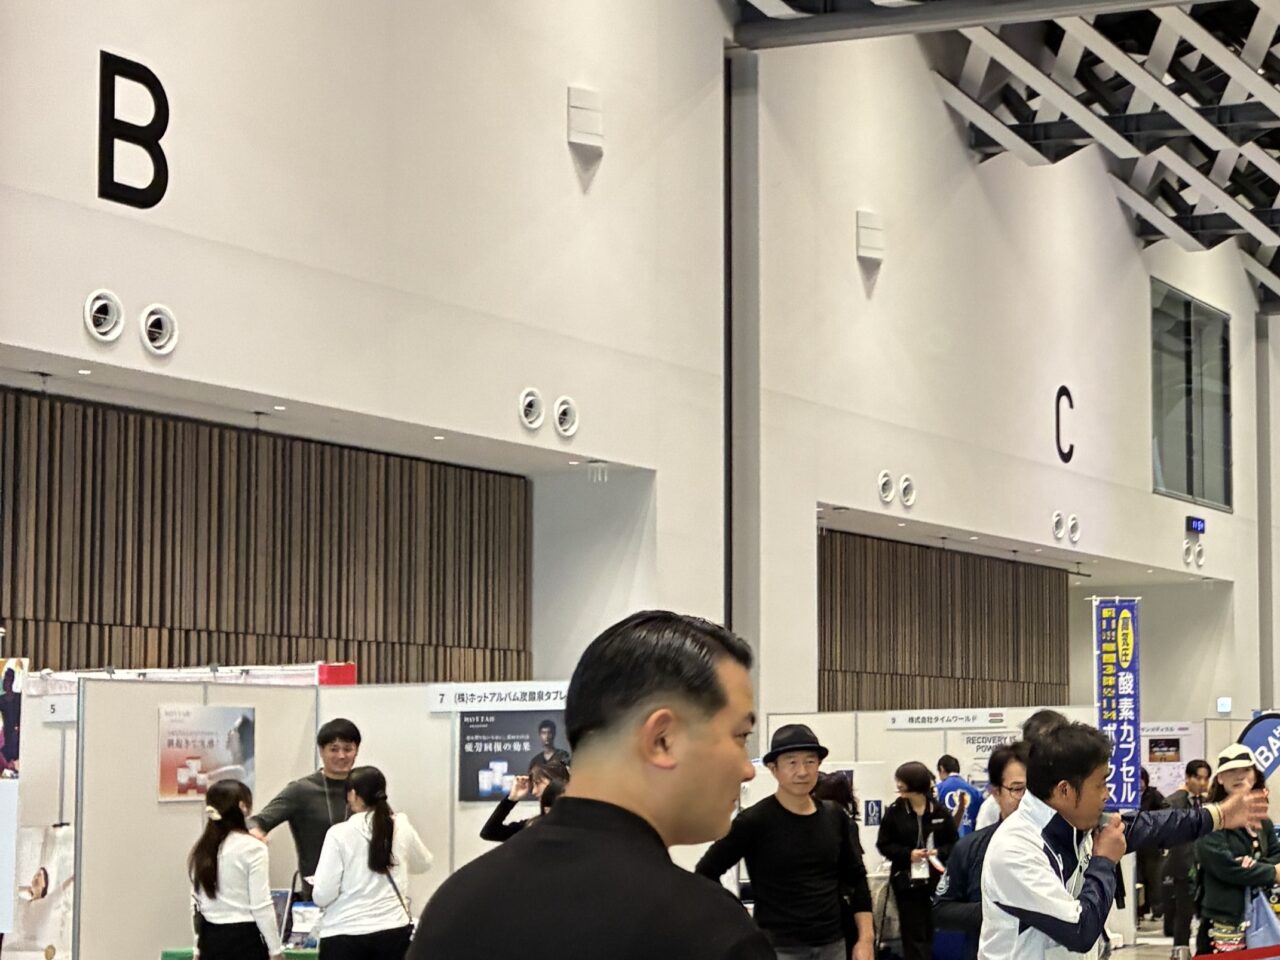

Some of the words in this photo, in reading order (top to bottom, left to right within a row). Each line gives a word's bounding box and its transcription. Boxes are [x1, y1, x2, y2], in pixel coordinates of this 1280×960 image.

[98, 49, 169, 209] B
[1054, 384, 1074, 464] C
[50, 704, 55, 714] 5
[439, 693, 445, 703] 7
[966, 736, 1008, 745] RECOVERY
[1118, 671, 1136, 803] 酸素カプセル
